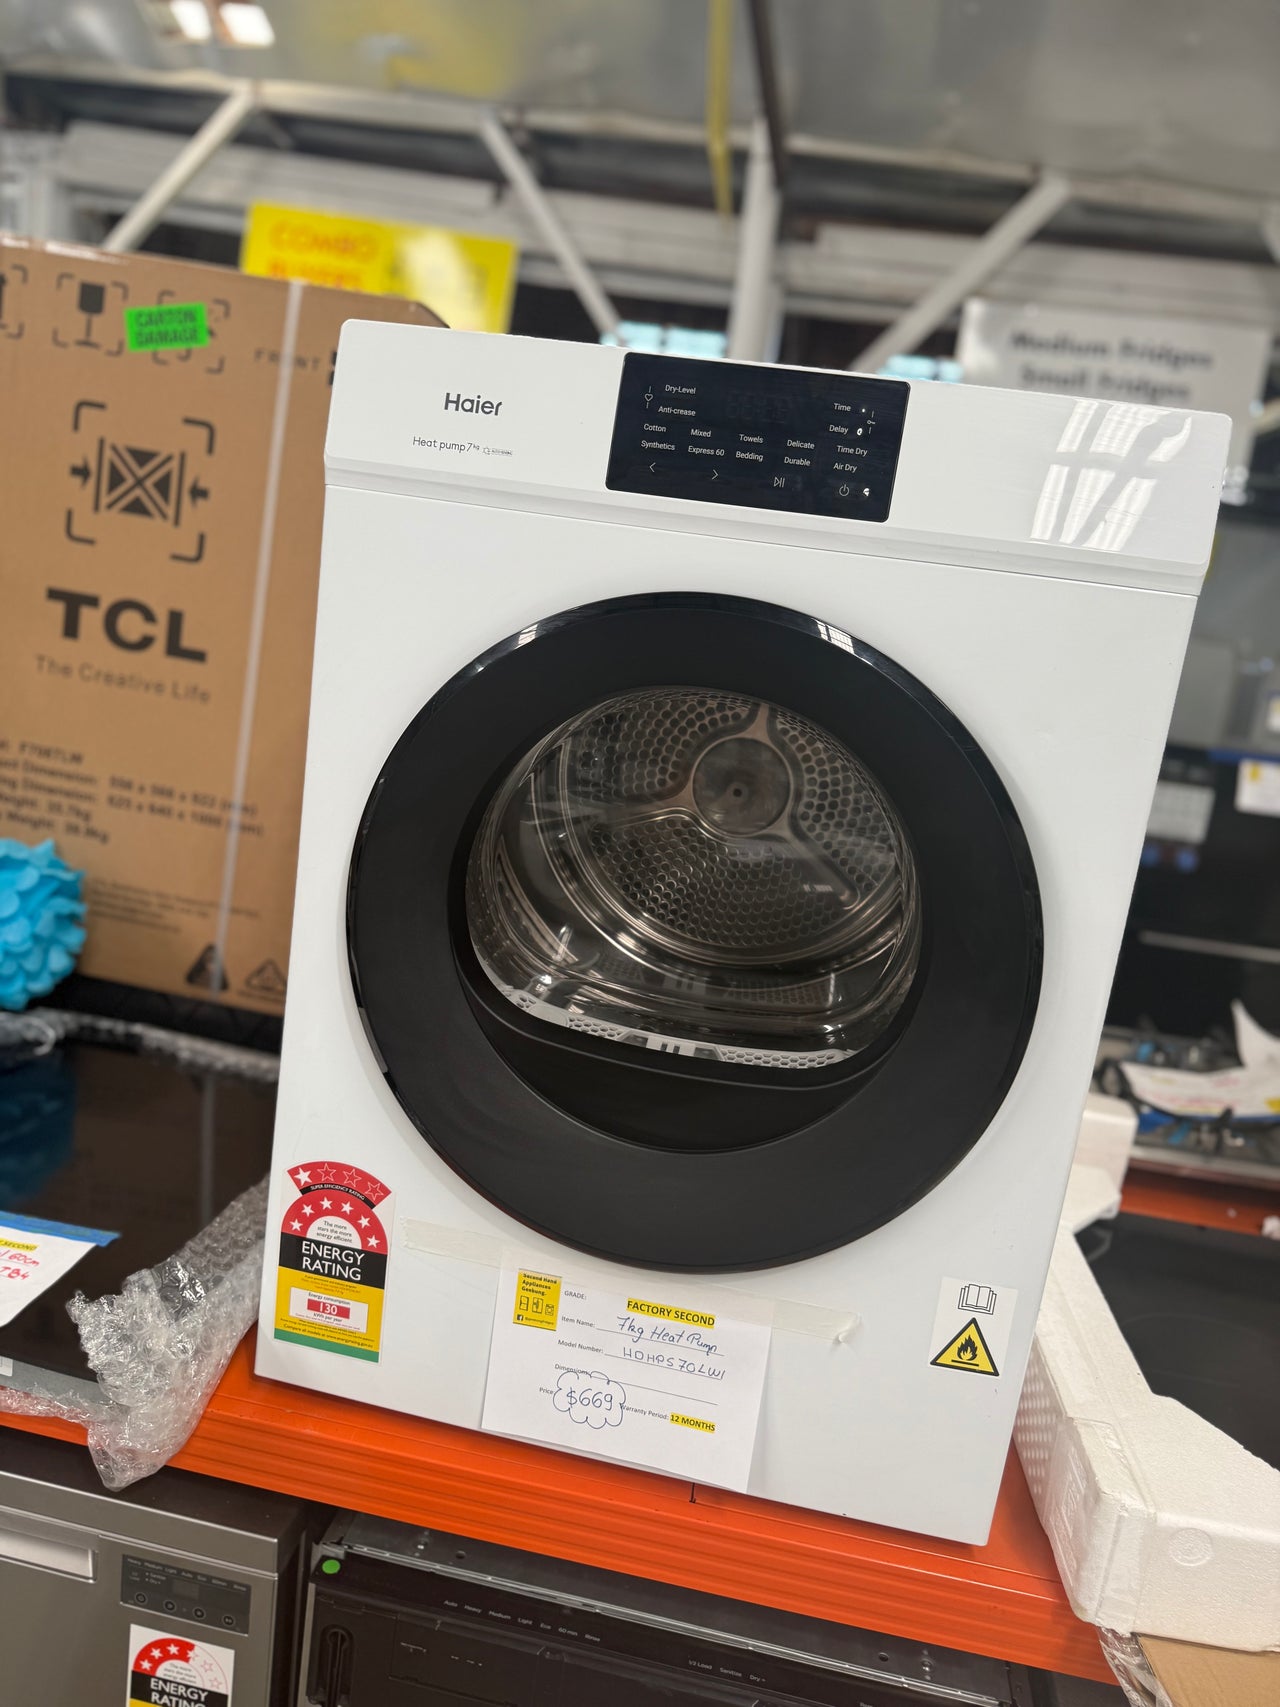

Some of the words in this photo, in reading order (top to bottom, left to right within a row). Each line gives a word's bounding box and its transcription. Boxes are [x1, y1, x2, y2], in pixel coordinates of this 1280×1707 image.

[254, 349, 320, 371] FRNT
[665, 384, 697, 395] Dry-Level
[444, 392, 503, 416] Haier
[833, 402, 852, 412] Time
[658, 406, 696, 417] Anti-crease
[644, 424, 666, 432] Cotton
[690, 428, 712, 438] Mixed
[829, 424, 849, 435] Delay
[412, 436, 437, 448] Heat
[439, 441, 466, 454] pump
[739, 434, 764, 444] Towels
[786, 440, 815, 450] Delicate
[641, 440, 676, 451] Synthetics
[688, 446, 714, 456] Express
[716, 448, 725, 456] 60
[837, 445, 854, 454] Time
[856, 447, 868, 458] Dry
[736, 451, 764, 462] Bedding
[784, 456, 811, 466] Durable
[833, 462, 844, 470] Air
[844, 464, 858, 474] Dry
[46, 587, 207, 664] TCL
[35, 654, 72, 679] The
[78, 661, 166, 696] Creative
[171, 681, 211, 705] Life
[324, 1184, 348, 1192] EFFICIENCY
[348, 1189, 365, 1200] RATING
[316, 1232, 332, 1240] energy
[302, 1240, 365, 1266] ENERGY
[302, 1257, 362, 1281] RATING
[523, 1274, 542, 1282] Second
[522, 1280, 552, 1290] Appliances
[308, 1292, 323, 1300] Energy
[324, 1295, 350, 1306] consumption
[564, 1290, 587, 1300] GRADE:
[320, 1302, 338, 1314] 130
[627, 1300, 672, 1318] FACTORY
[674, 1310, 716, 1326] SECOND
[562, 1316, 576, 1324] Item
[576, 1318, 596, 1328] Name:
[616, 1316, 644, 1343] 7kg
[650, 1325, 685, 1344] Heat
[558, 1340, 577, 1348] Model
[578, 1343, 604, 1354] Number:
[566, 1386, 613, 1411] $669
[648, 1410, 669, 1420] Period:
[670, 1414, 680, 1423] 12
[680, 1416, 716, 1432] MONTHS
[444, 1600, 458, 1608] Auto
[150, 1678, 208, 1702] ENERGY
